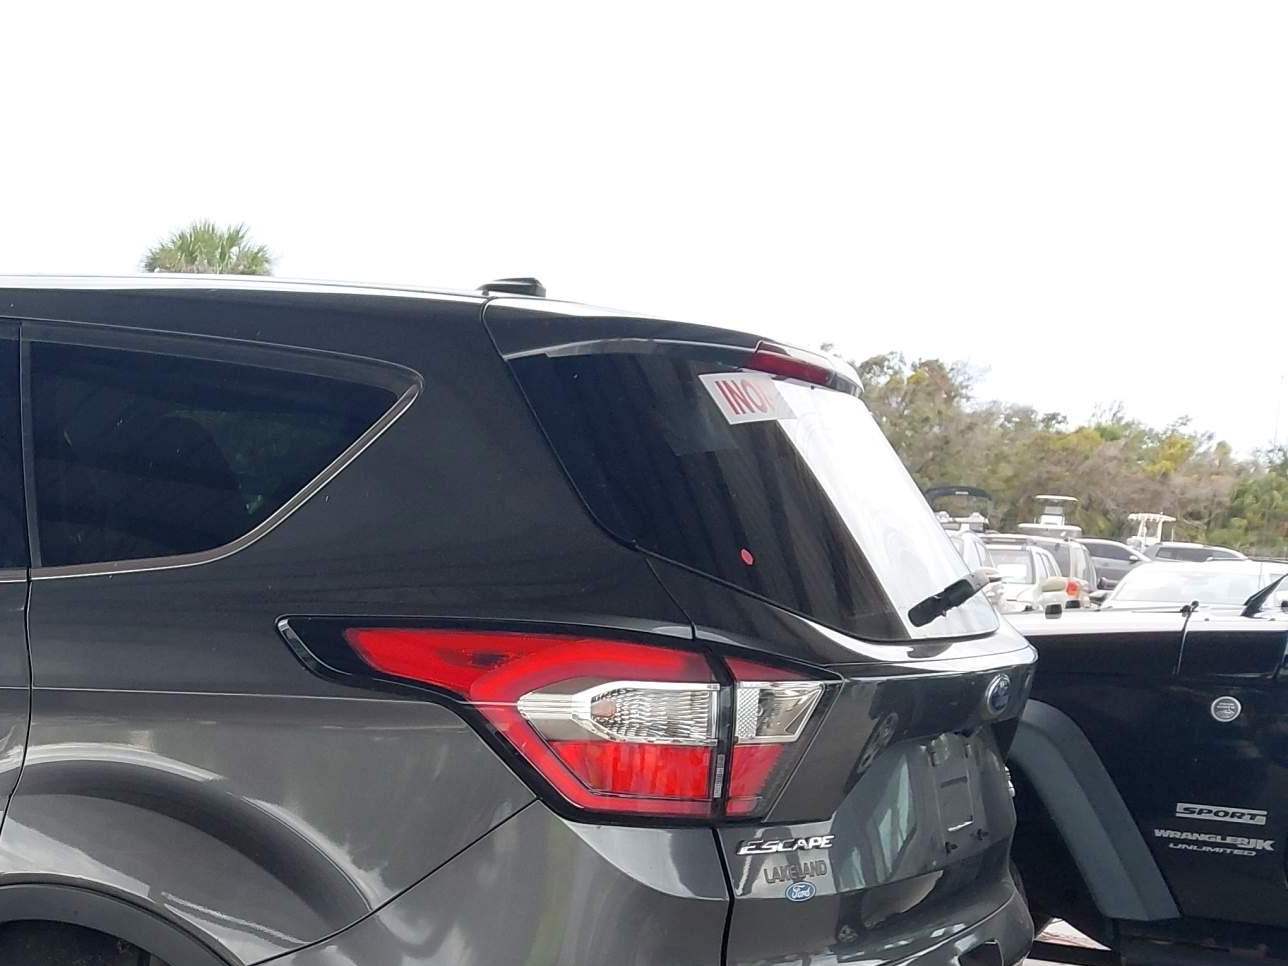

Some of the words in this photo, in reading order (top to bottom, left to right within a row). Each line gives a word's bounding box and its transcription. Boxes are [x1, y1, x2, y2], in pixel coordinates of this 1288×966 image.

[1182, 806, 1258, 822] SPORT
[737, 835, 834, 854] ESCAPE
[1169, 843, 1257, 856] UNLIMITED
[764, 860, 827, 883] LAKELAND
